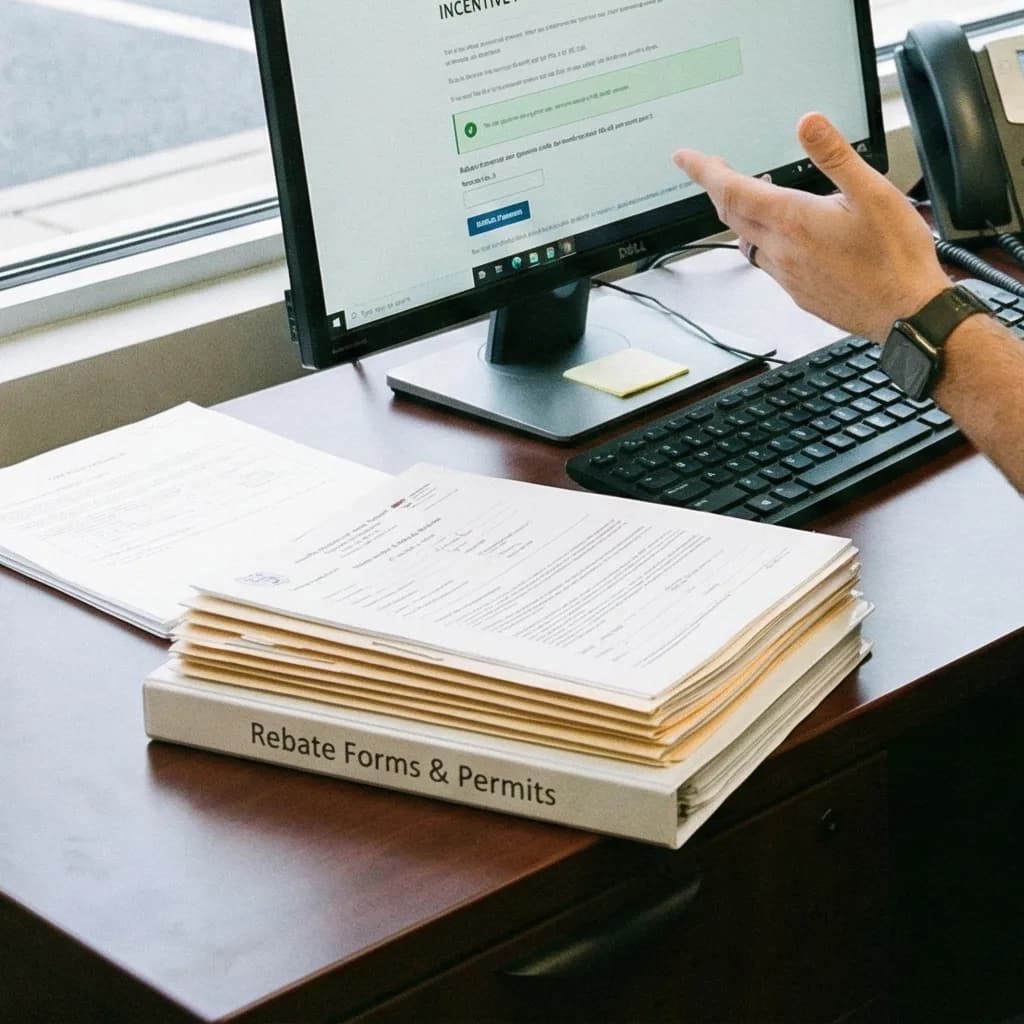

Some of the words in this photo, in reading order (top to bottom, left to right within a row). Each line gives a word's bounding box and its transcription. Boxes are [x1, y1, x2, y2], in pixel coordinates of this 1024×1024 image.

[251, 721, 336, 761] Rebate
[344, 741, 421, 778] Forms
[428, 758, 449, 785] &
[458, 764, 556, 806] Permits
